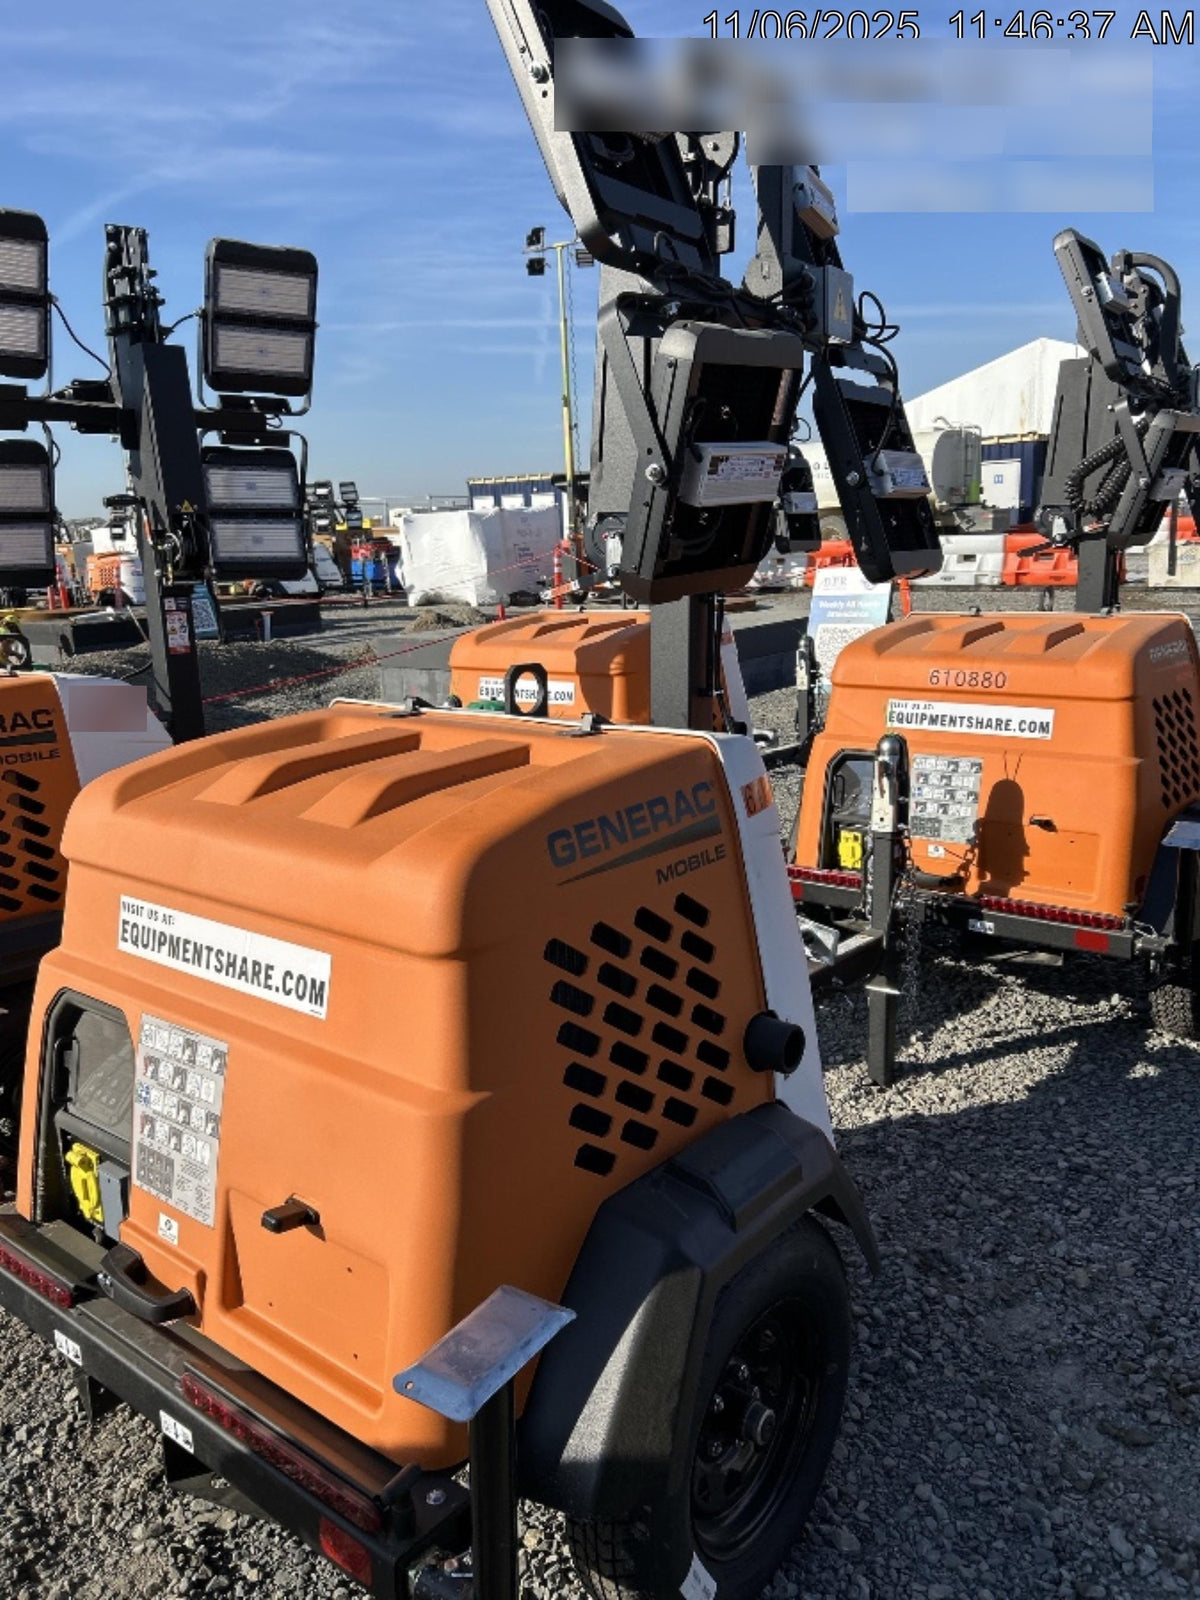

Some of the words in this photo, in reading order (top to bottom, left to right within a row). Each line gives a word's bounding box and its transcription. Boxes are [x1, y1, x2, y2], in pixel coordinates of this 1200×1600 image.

[929, 669, 1008, 689] 610880
[888, 710, 1051, 735] EQUIPMENTSHARE.COM
[546, 781, 716, 868] GENERAC
[655, 843, 728, 885] MOBILE
[122, 900, 145, 918] VISIT
[146, 908, 159, 921] US
[120, 917, 326, 1008] EQUIPMENTSHARE.COM
